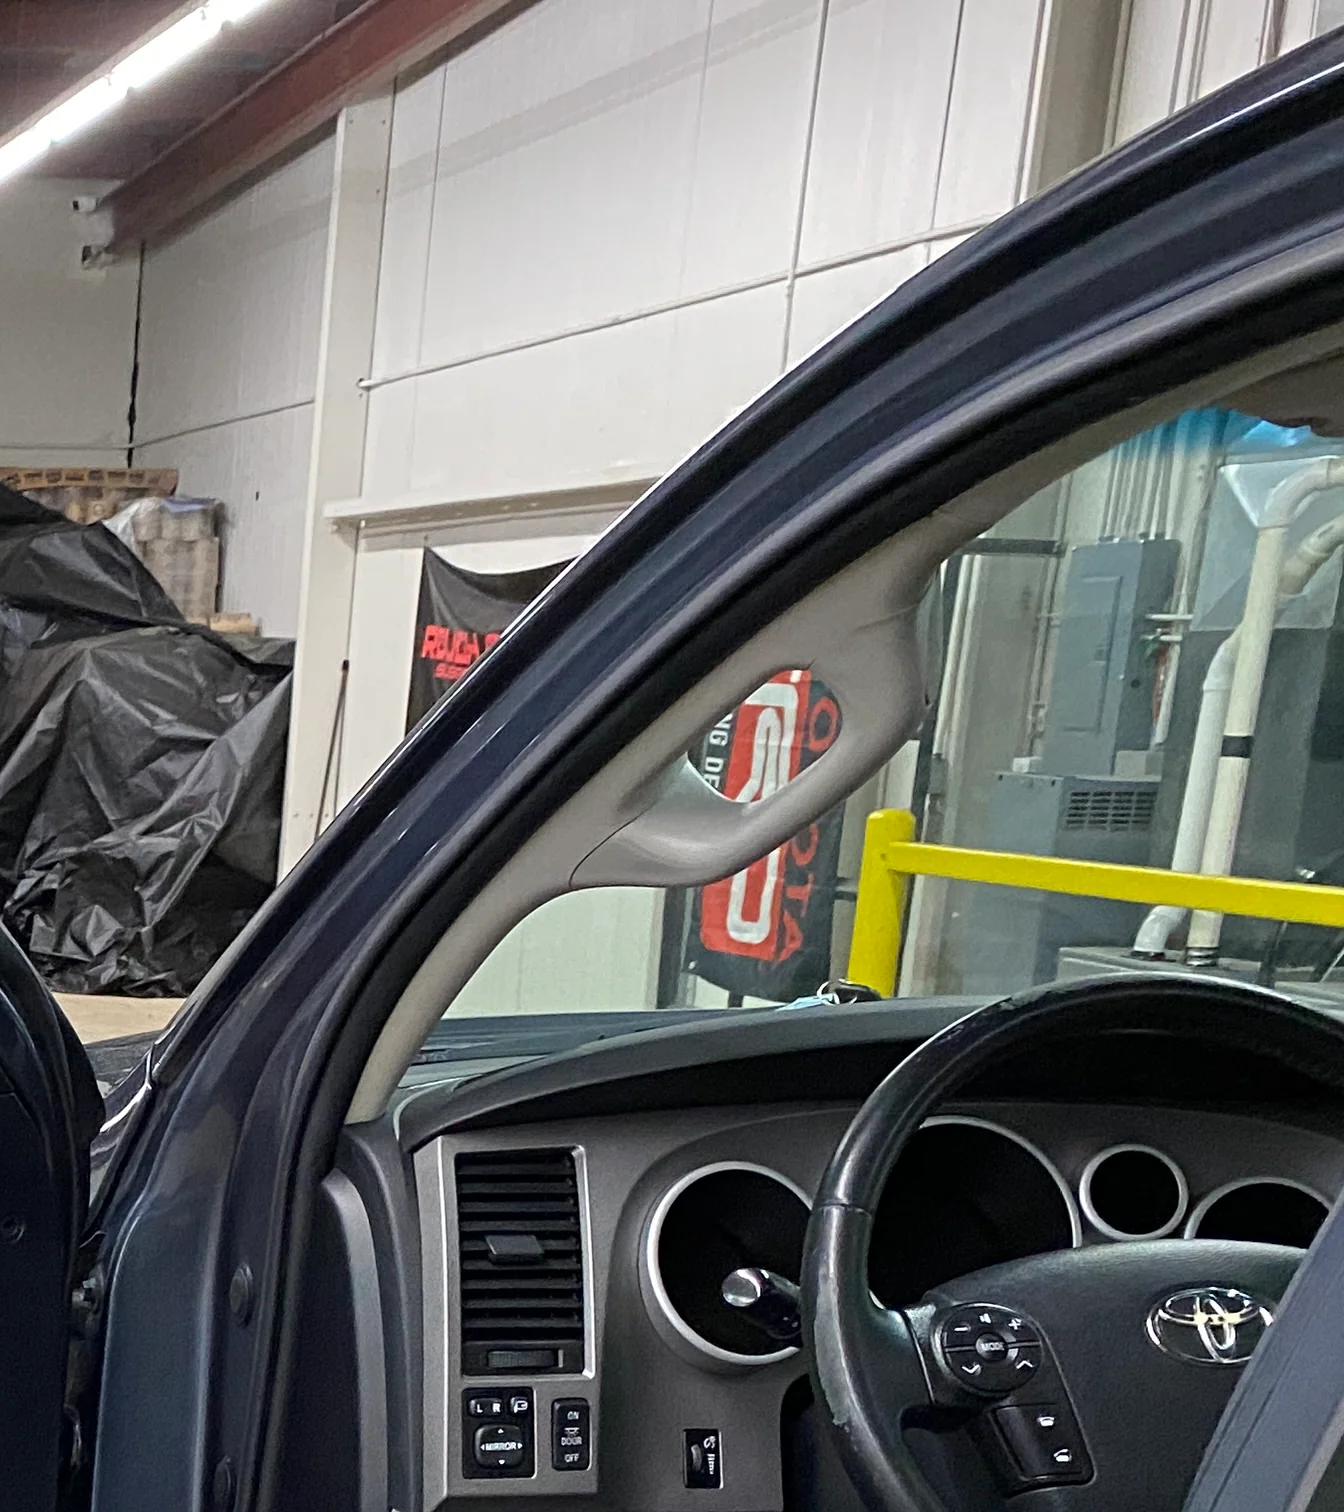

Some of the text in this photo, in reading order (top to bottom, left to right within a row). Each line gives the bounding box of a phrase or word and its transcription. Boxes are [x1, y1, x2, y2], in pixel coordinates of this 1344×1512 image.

[476, 1402, 501, 1413] L R
[567, 1411, 580, 1420] ON
[485, 1441, 517, 1451] MIRROR
[560, 1436, 583, 1446] DOOR
[564, 1453, 580, 1463] OFF
